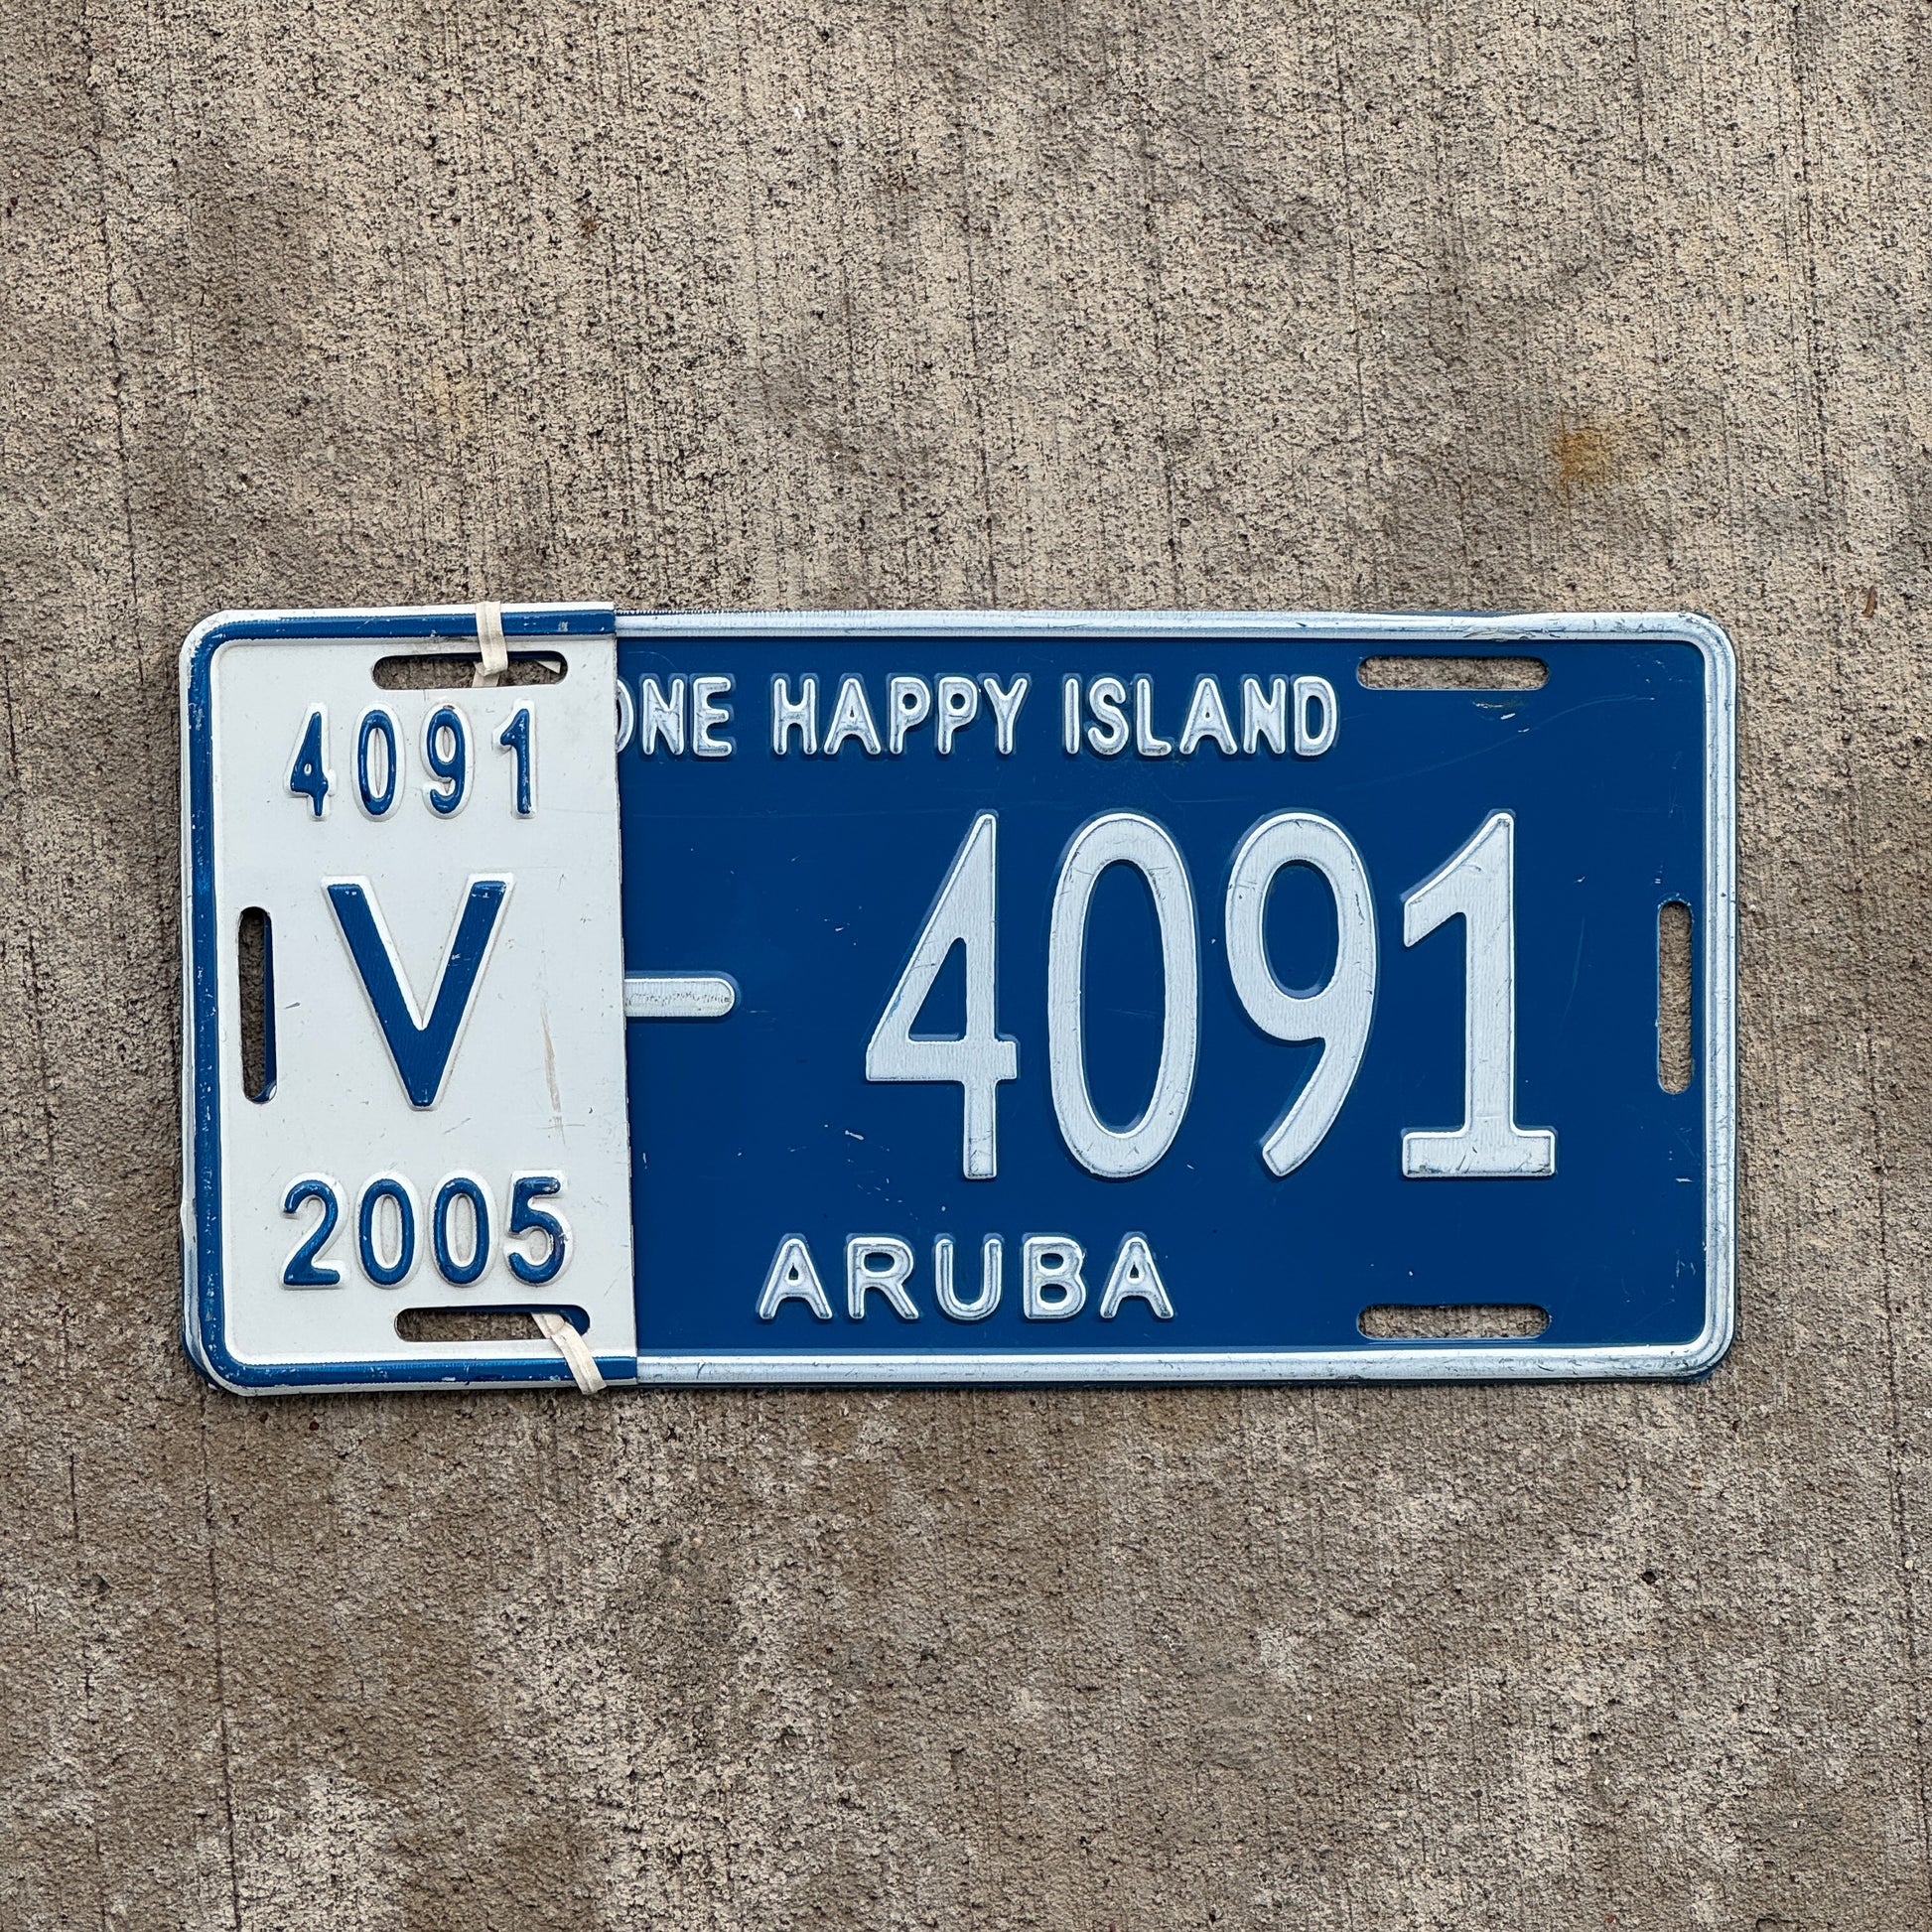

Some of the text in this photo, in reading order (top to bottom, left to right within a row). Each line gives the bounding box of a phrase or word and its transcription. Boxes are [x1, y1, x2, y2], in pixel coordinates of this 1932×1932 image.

[290, 706, 537, 817] 4091
[772, 676, 1027, 757] HAPPY
[1064, 676, 1338, 757] ISLAND
[328, 880, 507, 1108] V
[865, 811, 1557, 1179] 4091
[284, 1175, 567, 1287] 2005
[759, 1234, 1173, 1318] ARUBA
